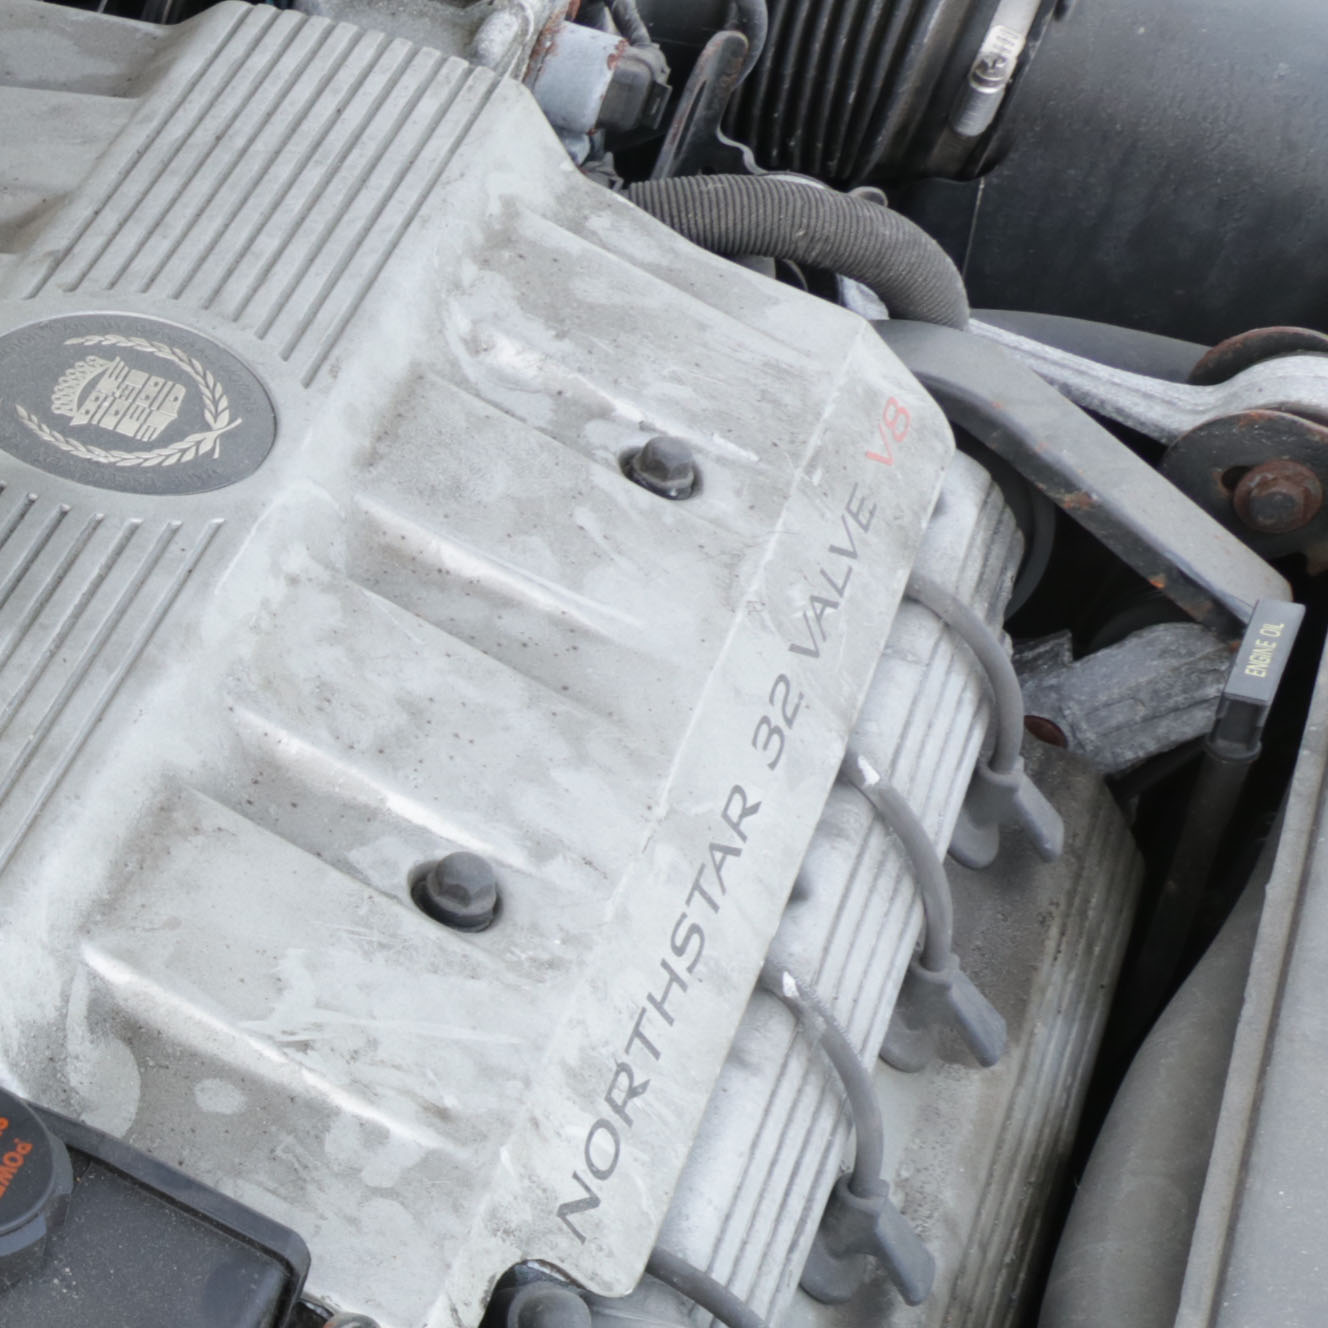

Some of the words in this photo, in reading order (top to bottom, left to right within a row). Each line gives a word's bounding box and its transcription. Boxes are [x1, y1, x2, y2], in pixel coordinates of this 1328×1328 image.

[1260, 623, 1285, 638] OIL
[1245, 639, 1277, 678] ENGINE
[555, 784, 763, 1245] NORTHSTAR
[751, 674, 808, 771] 32
[789, 487, 877, 660] VALVE
[865, 396, 913, 469] V8
